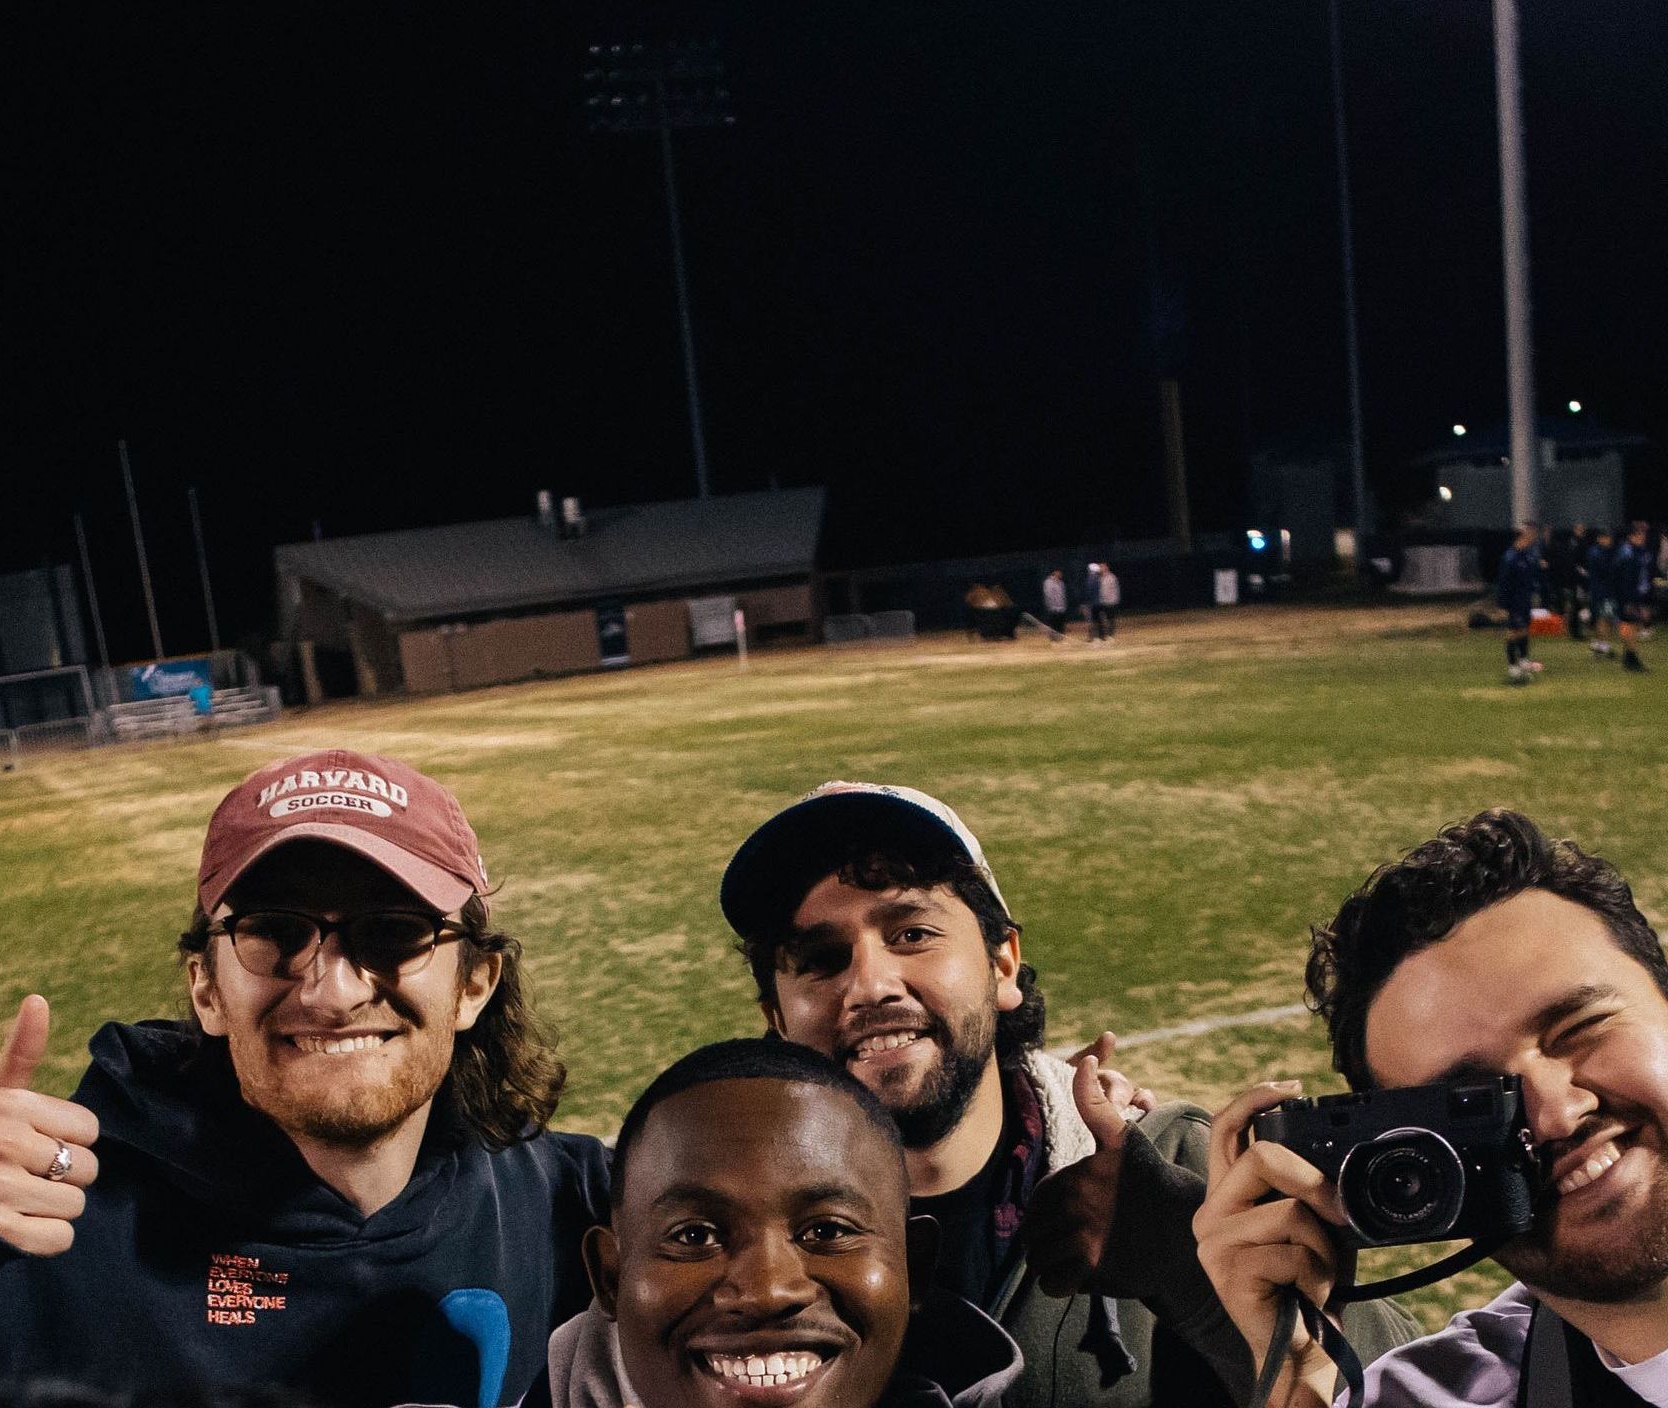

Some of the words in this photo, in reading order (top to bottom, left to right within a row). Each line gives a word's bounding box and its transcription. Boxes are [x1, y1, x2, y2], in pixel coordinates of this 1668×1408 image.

[257, 770, 408, 808] HARVARD
[287, 794, 374, 812] SOCCER
[212, 1253, 260, 1269] WHEN
[208, 1278, 253, 1295] LOVES
[207, 1294, 286, 1310] EVERYONE
[207, 1309, 256, 1326] HEALS
